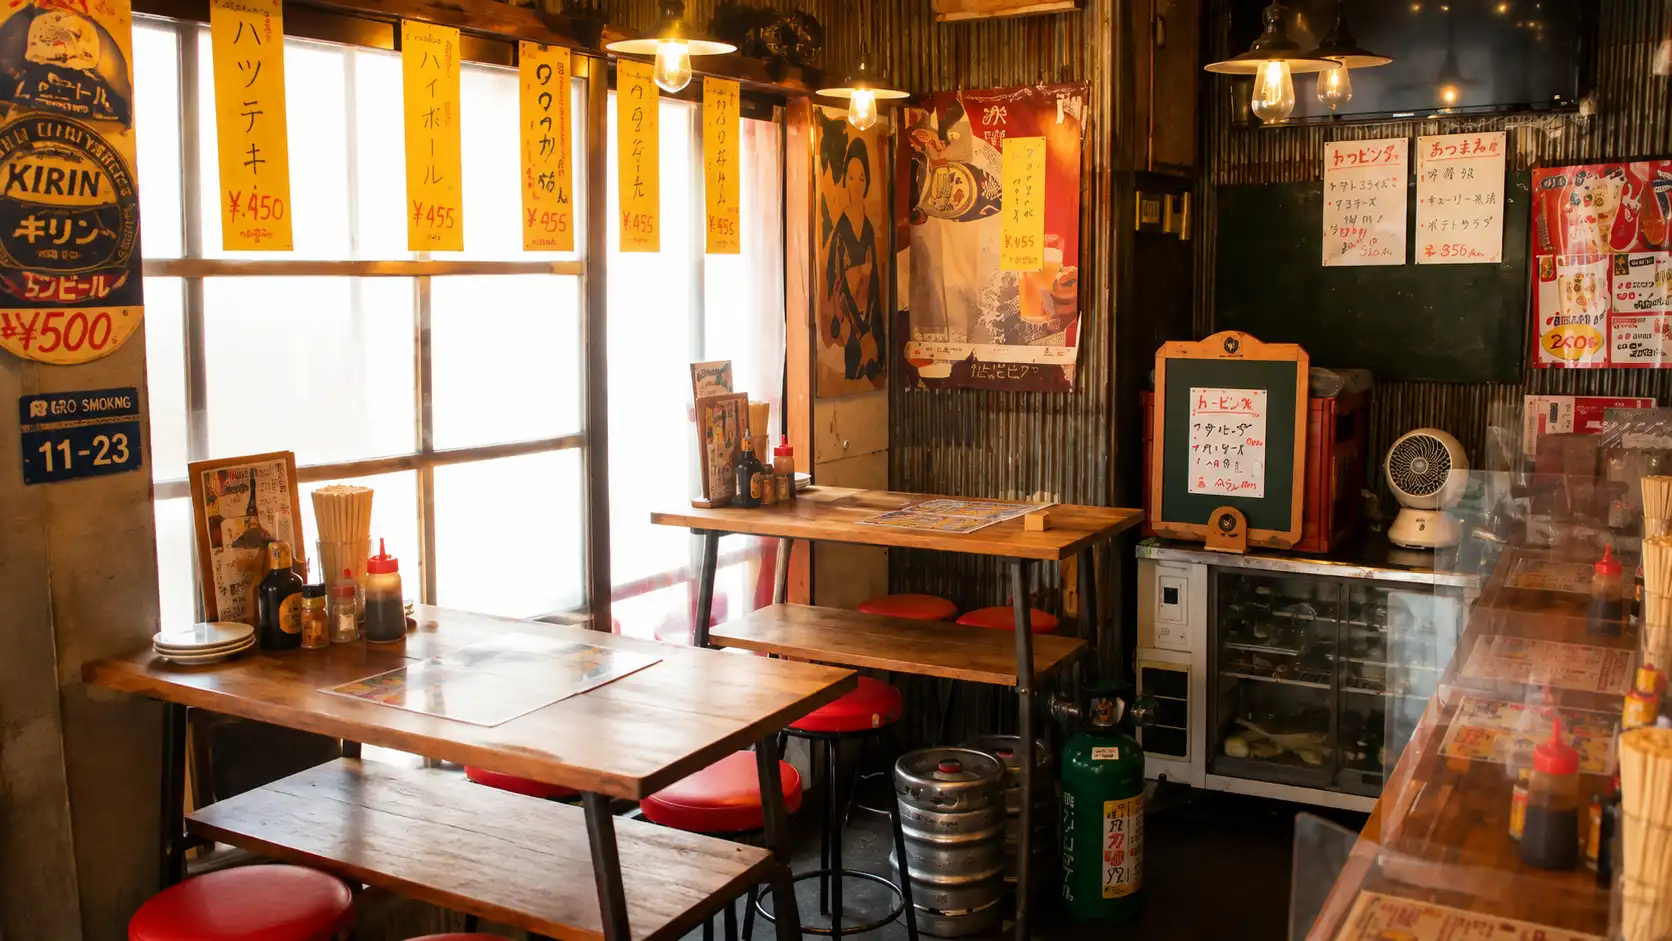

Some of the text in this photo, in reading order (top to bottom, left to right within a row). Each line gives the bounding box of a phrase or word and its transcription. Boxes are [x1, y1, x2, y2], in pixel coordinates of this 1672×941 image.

[420, 51, 442, 185] ハイボール
[4, 163, 101, 198] KIRIN
[12, 214, 99, 244] キリン
[82, 396, 132, 413] SMOKNG
[39, 433, 130, 472] 11-23
